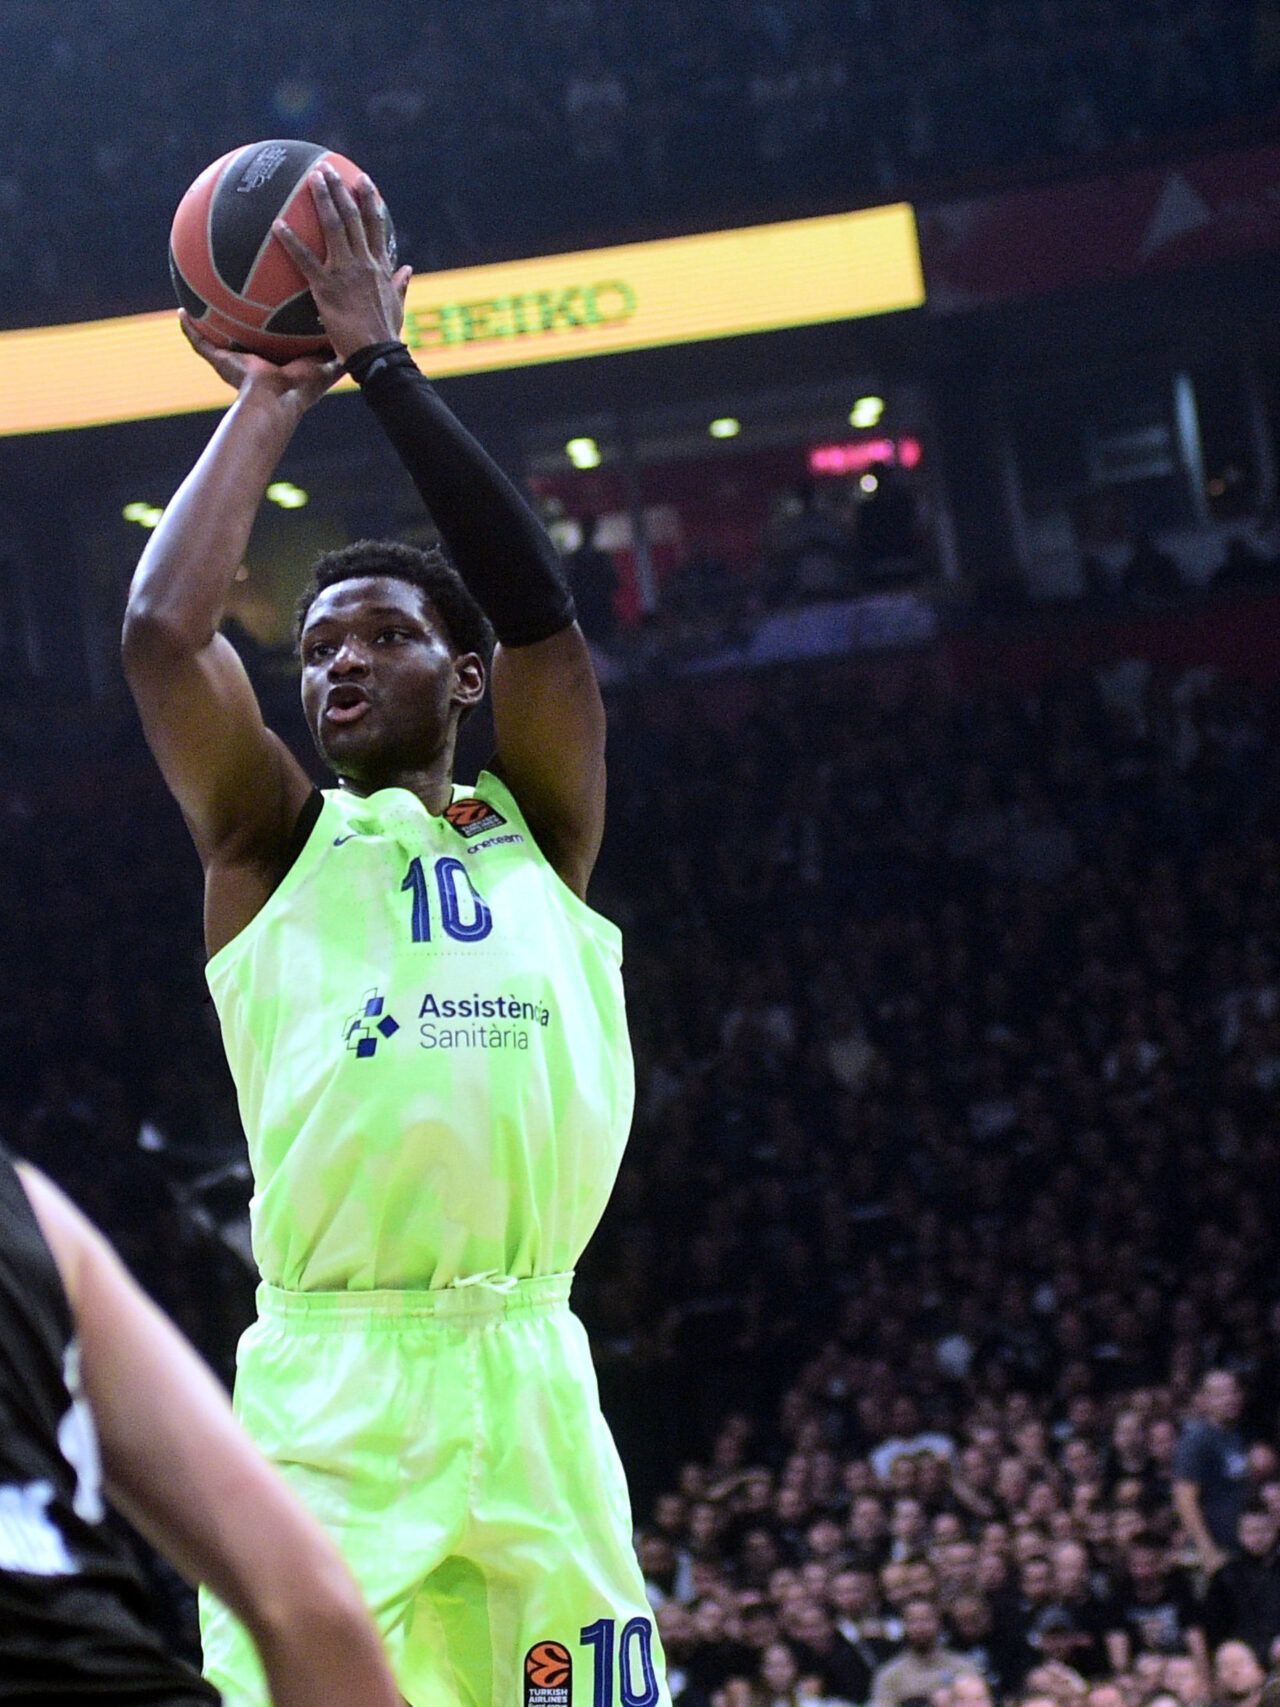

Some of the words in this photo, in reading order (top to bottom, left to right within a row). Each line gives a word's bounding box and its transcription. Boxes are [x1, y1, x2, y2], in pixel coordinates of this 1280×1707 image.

[406, 279, 636, 349] SEIKO
[467, 834, 524, 855] oneteam
[401, 857, 493, 943] 10
[420, 1023, 528, 1051] Sanitària
[580, 1616, 660, 1707] 10
[528, 1688, 569, 1696] TURKISH
